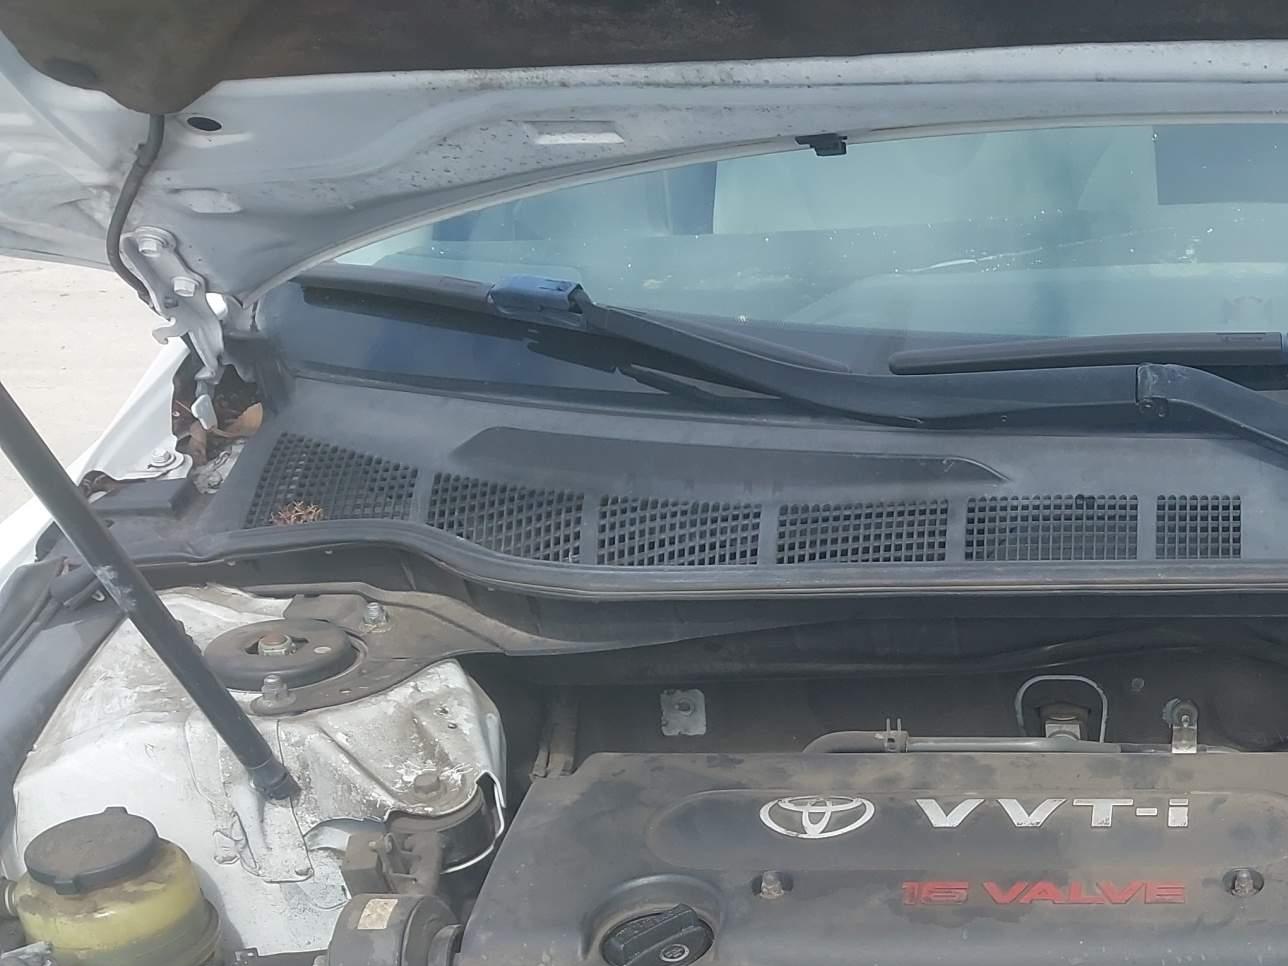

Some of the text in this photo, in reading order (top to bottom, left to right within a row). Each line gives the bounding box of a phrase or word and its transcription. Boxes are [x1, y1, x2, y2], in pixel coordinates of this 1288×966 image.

[914, 798, 1190, 829] VVT-i
[902, 880, 1186, 905] 16 VALVE
